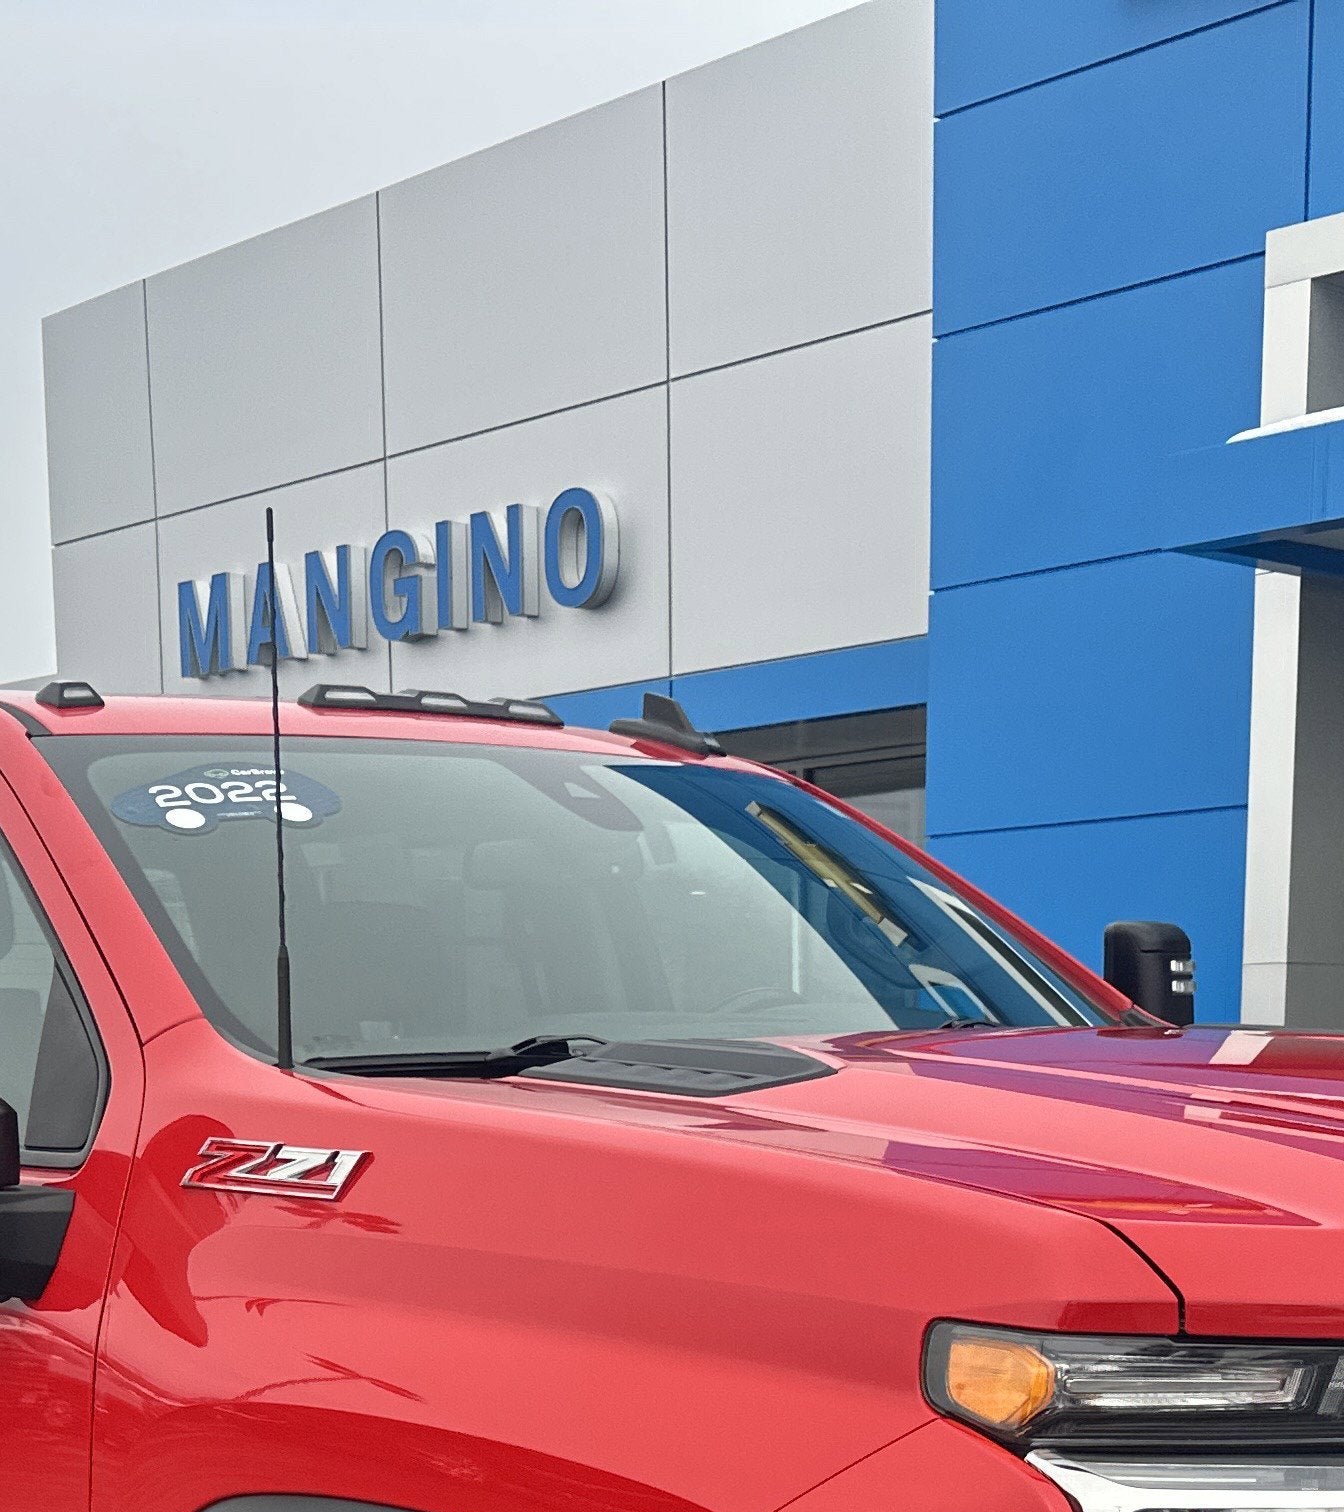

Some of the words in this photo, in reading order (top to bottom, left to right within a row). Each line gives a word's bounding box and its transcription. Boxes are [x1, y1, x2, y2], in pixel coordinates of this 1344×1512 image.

[178, 487, 619, 677] MANGINO
[148, 781, 297, 808] 2022
[181, 1136, 375, 1200] Z71
